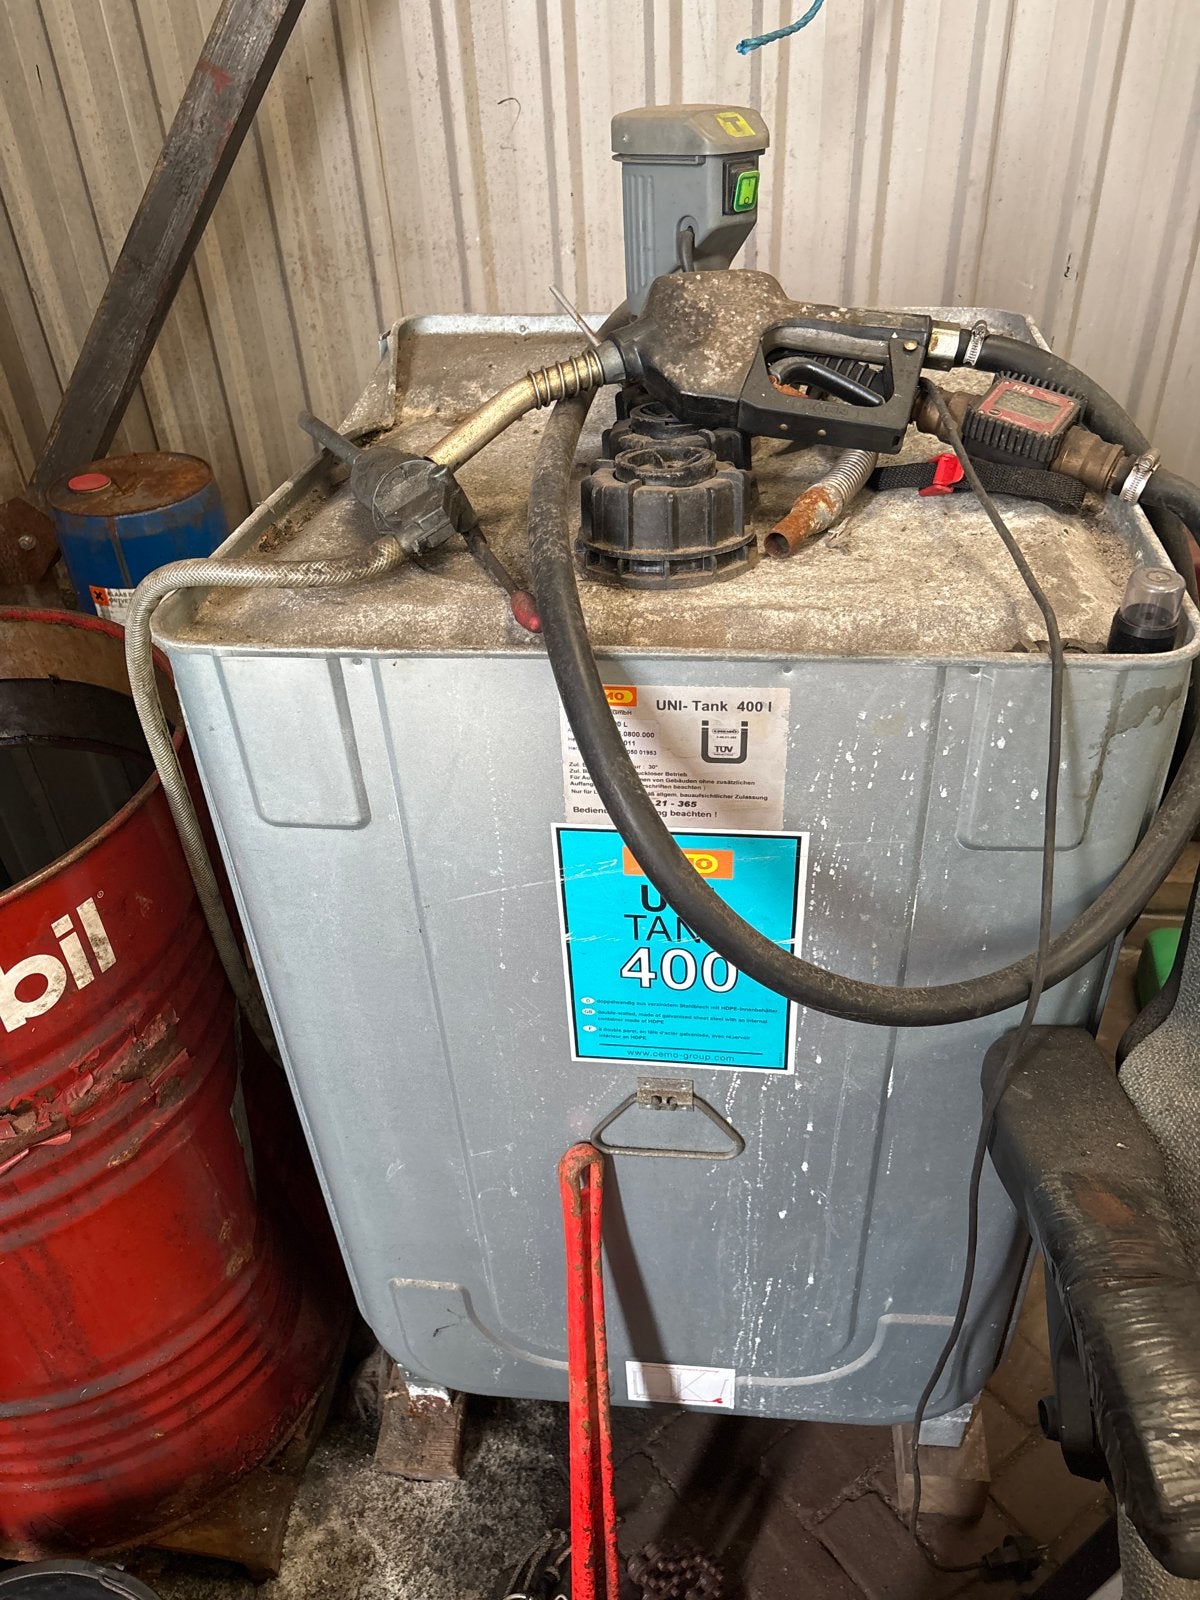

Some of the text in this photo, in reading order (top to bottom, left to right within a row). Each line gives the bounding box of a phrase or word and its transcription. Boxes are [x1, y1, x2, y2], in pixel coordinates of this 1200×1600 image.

[692, 700, 728, 712] Tank
[737, 701, 763, 713] 400
[677, 800, 697, 808] 365
[735, 794, 768, 802] Zulassung
[670, 810, 712, 818] beachten
[624, 914, 701, 944] TAN
[620, 946, 739, 993] 400
[626, 1049, 735, 1063] www.cemo-group.com
